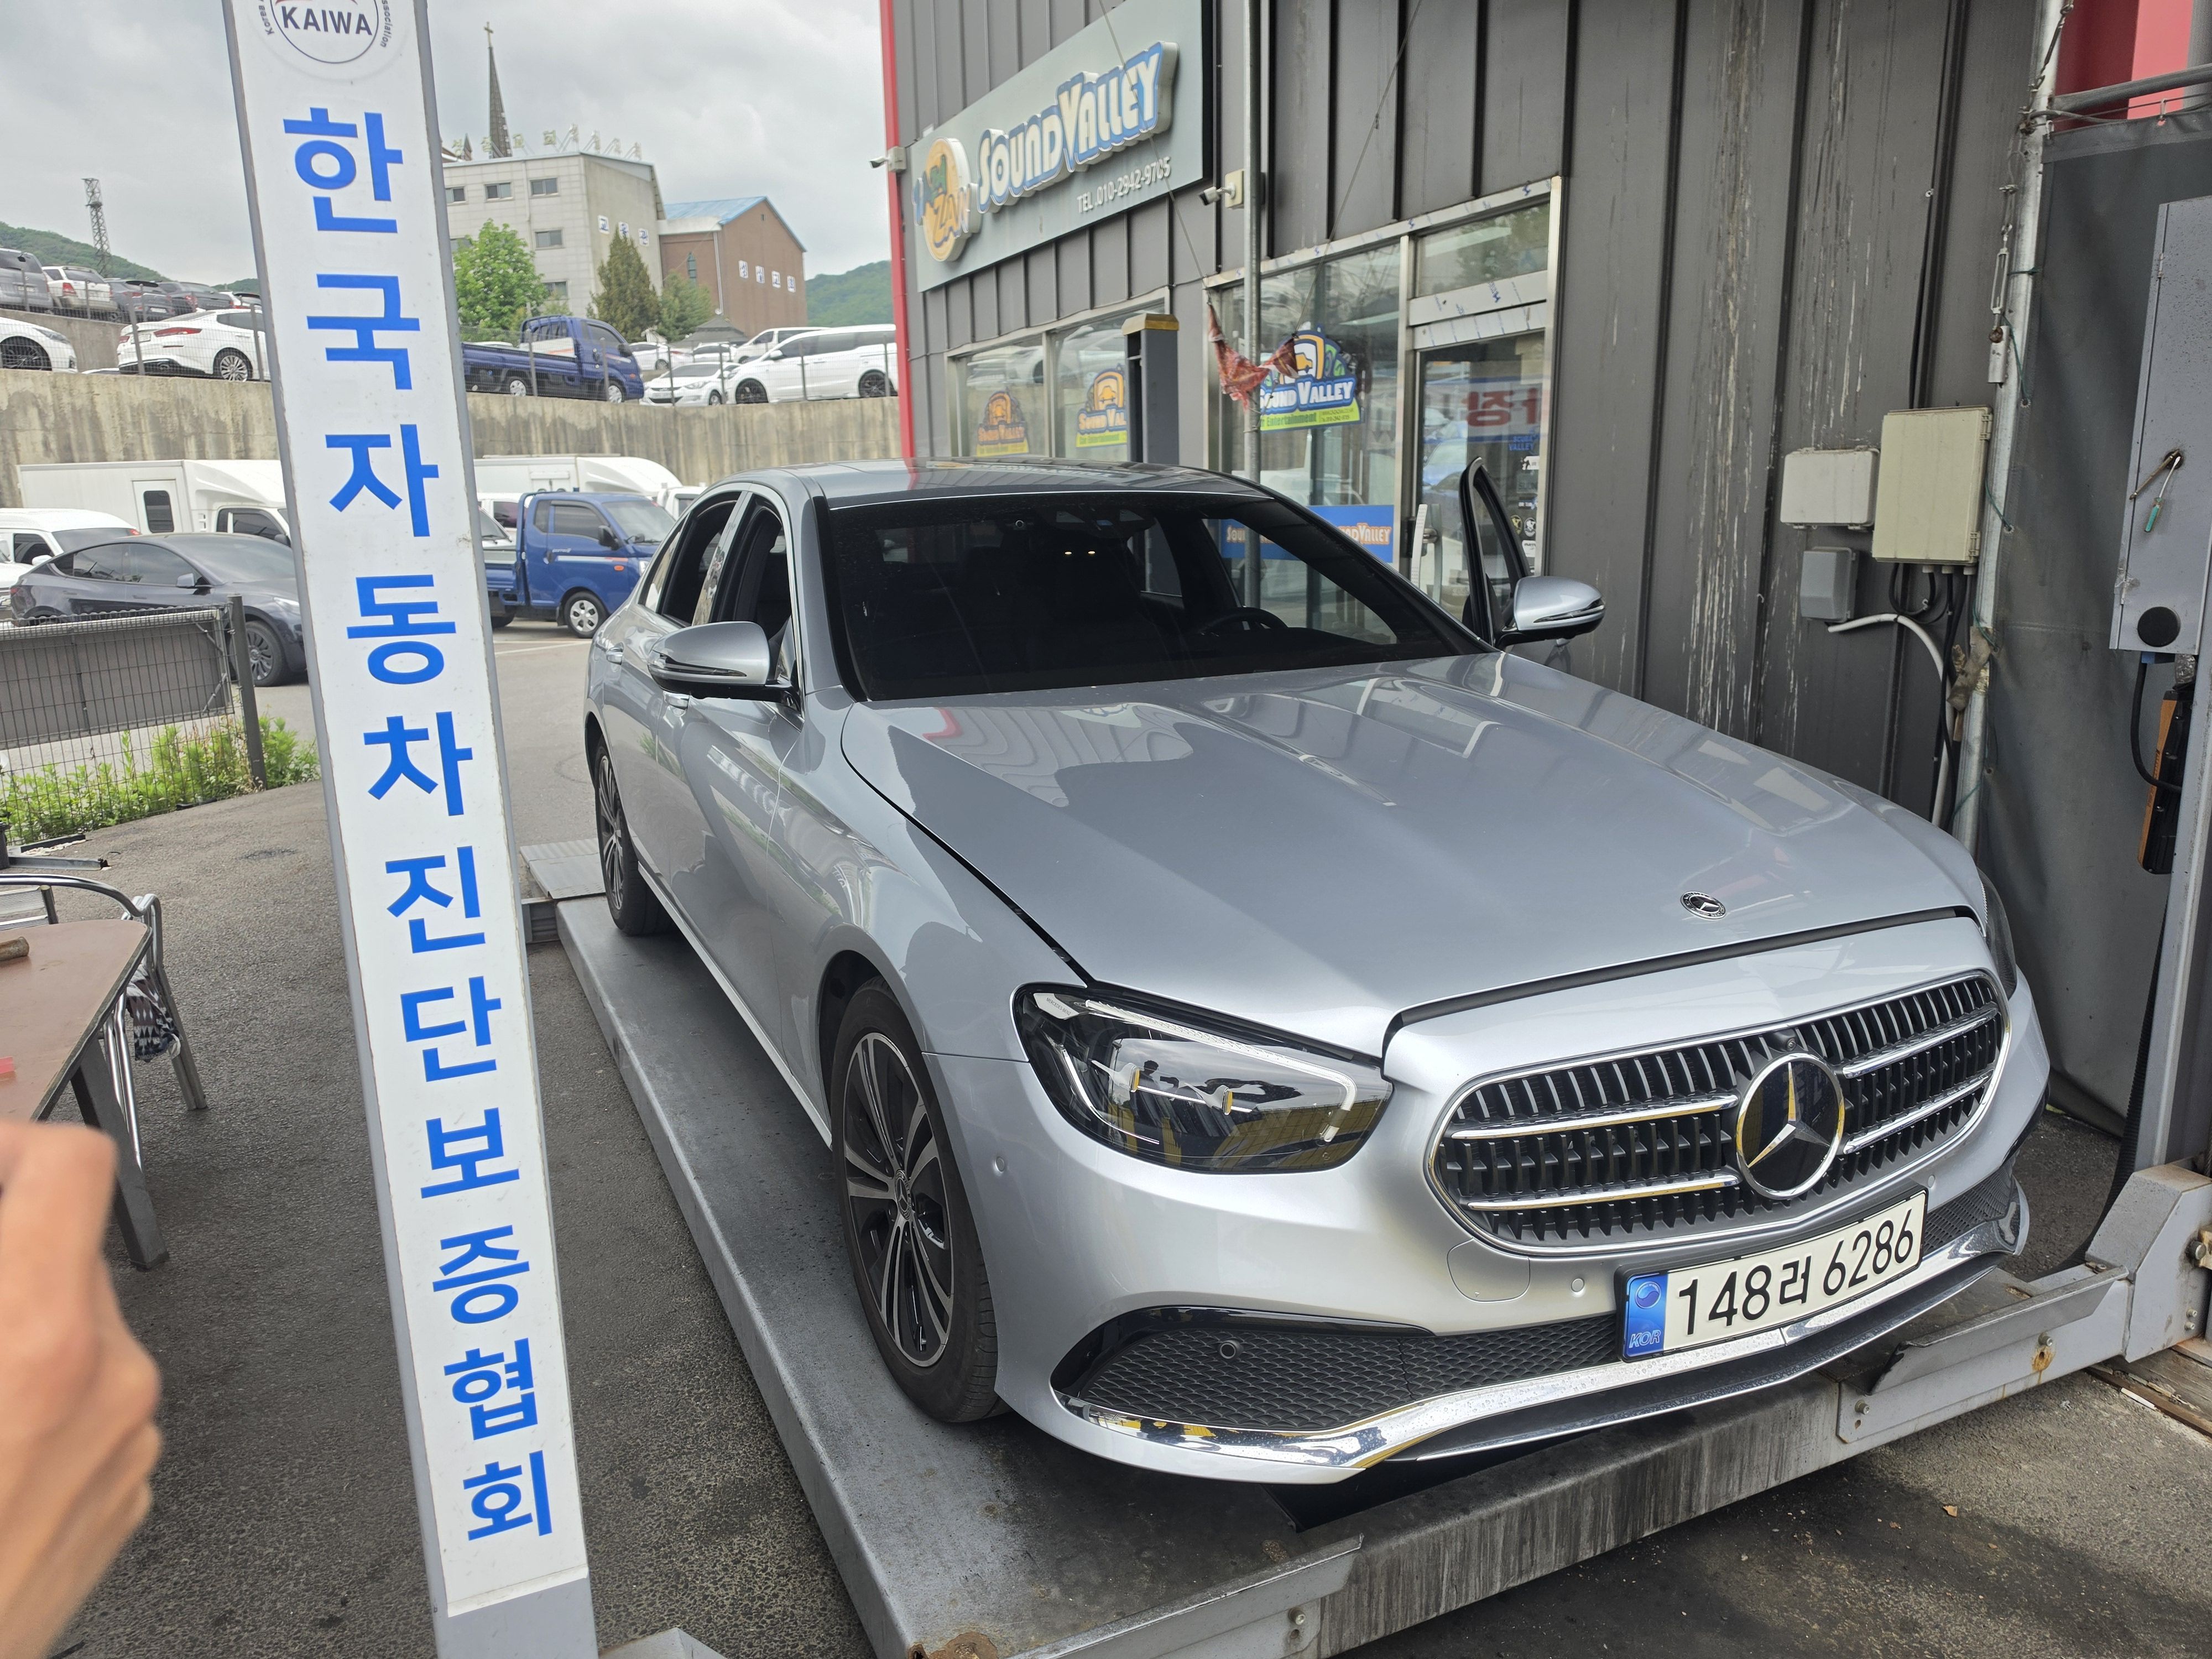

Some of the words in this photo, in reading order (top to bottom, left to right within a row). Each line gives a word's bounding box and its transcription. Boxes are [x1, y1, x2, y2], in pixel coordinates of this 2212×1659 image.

[281, 6, 372, 35] KAIWA
[380, 0, 393, 48] ssociation
[1297, 380, 1354, 405] VALLEY
[283, 107, 552, 1540] 한국자동차진단보증협회
[1678, 1256, 1811, 1335] 148러
[1823, 1208, 1913, 1296] 6286
[1629, 1329, 1662, 1348] KOR
